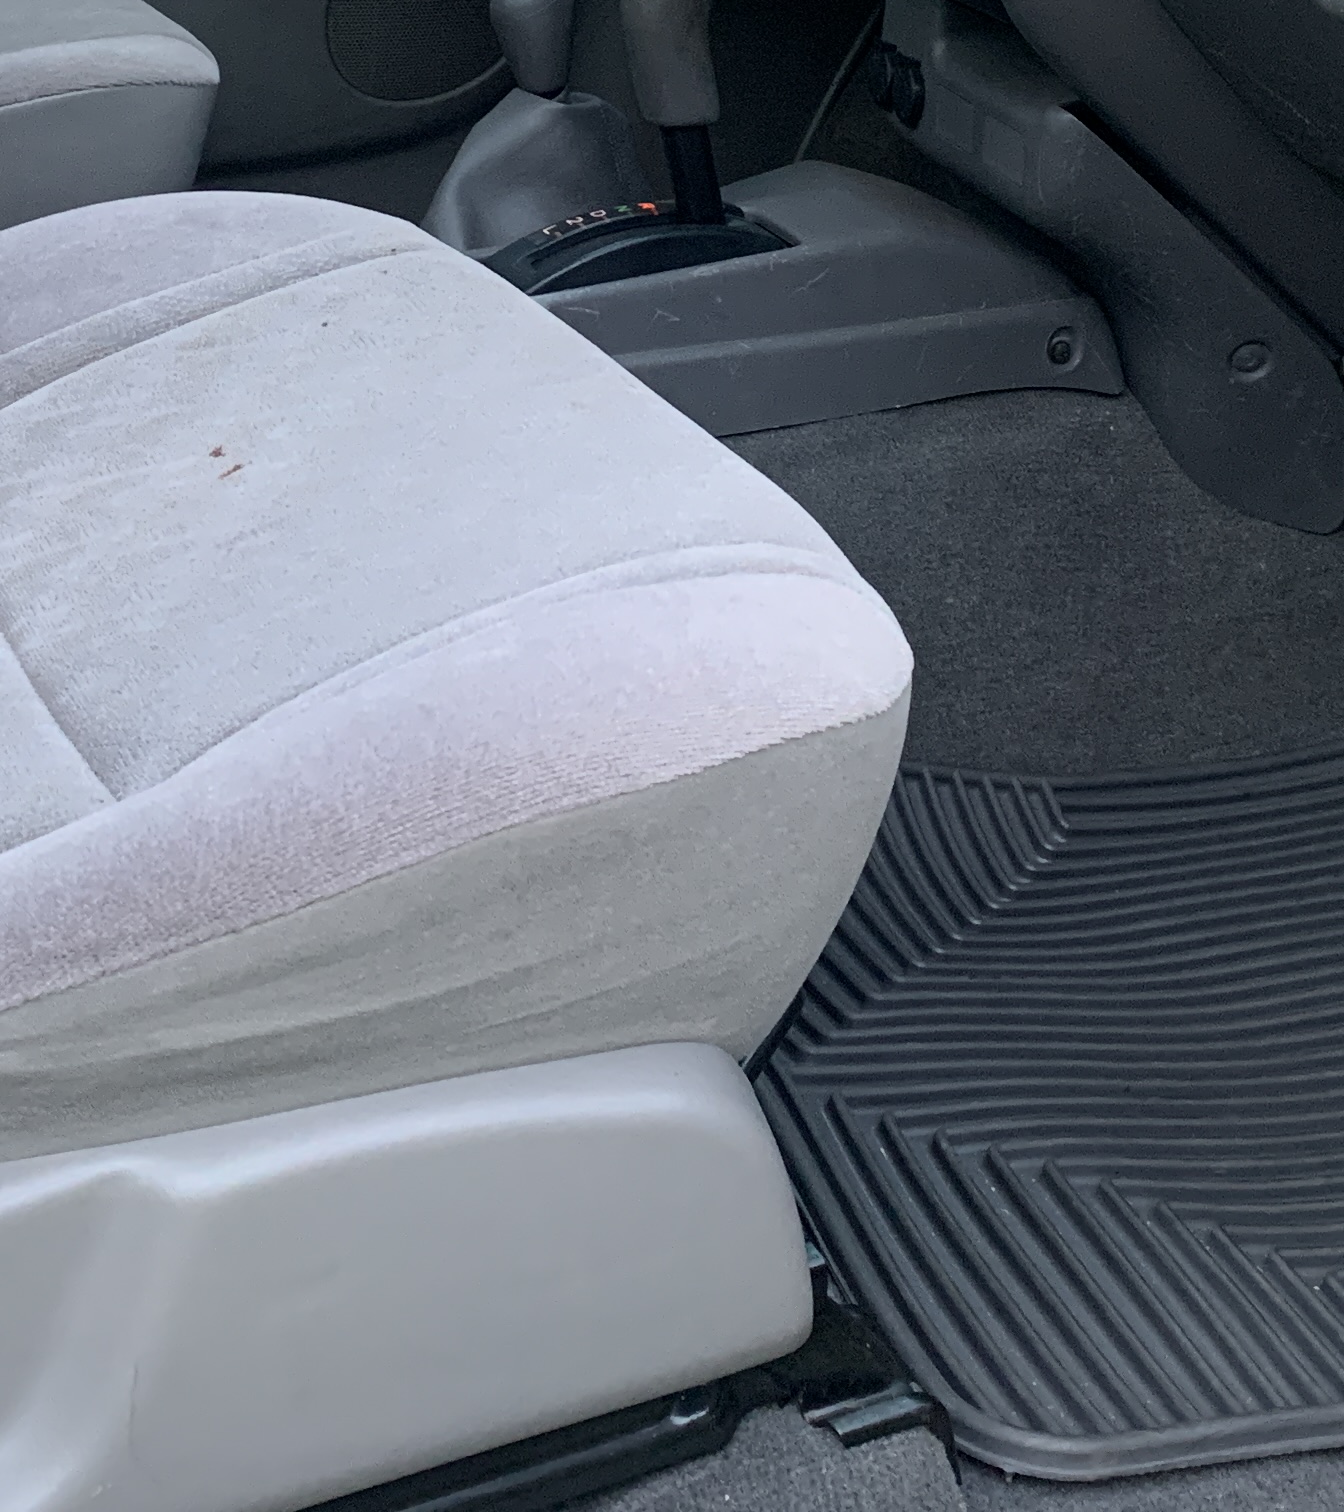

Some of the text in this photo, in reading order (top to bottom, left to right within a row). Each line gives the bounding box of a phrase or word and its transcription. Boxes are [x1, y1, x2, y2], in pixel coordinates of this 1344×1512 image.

[590, 209, 606, 218] D
[565, 216, 584, 226] 2
[542, 224, 557, 236] L
